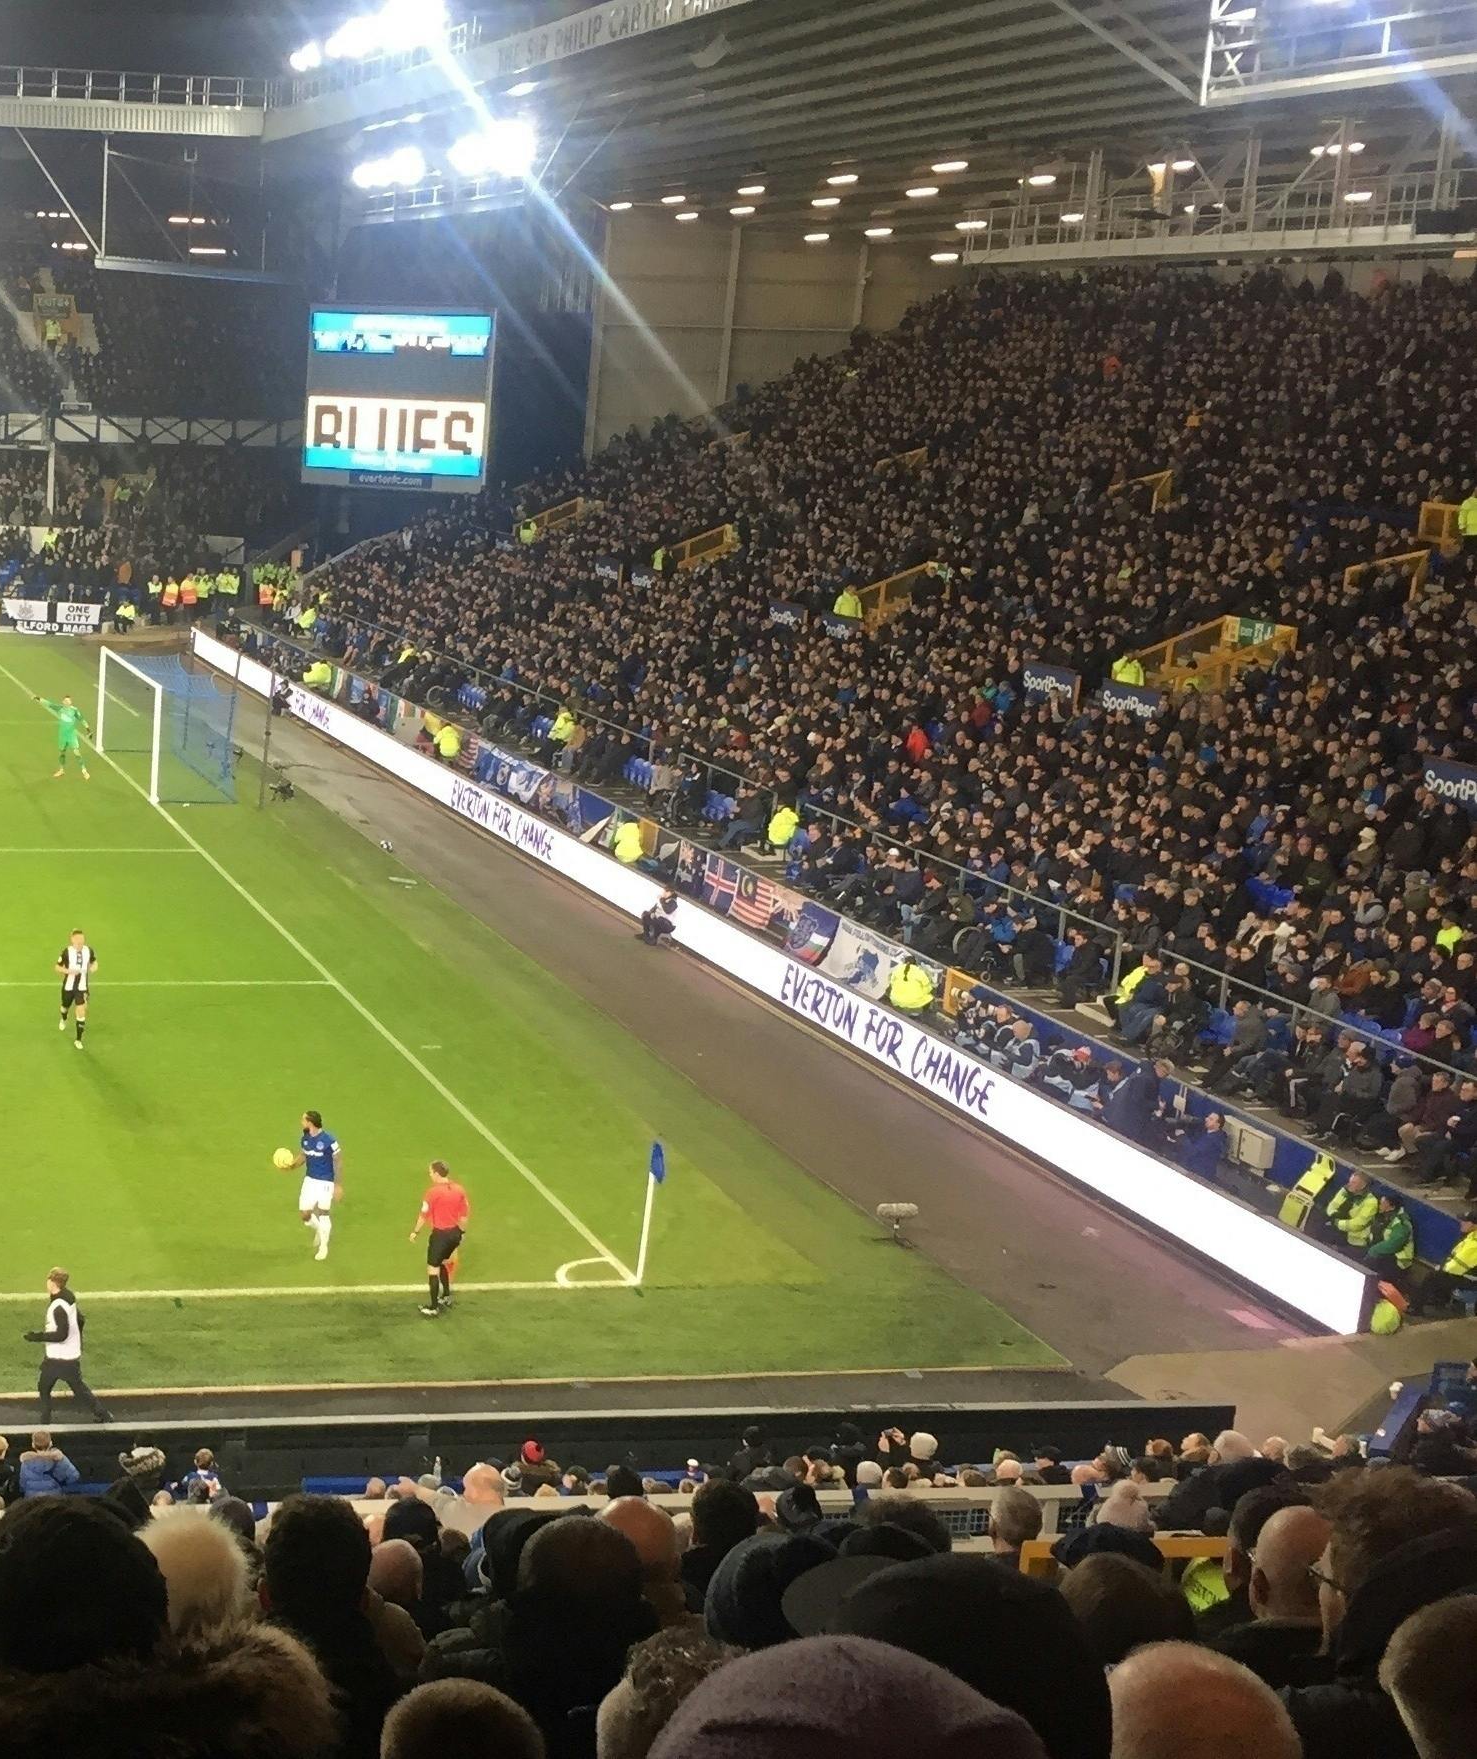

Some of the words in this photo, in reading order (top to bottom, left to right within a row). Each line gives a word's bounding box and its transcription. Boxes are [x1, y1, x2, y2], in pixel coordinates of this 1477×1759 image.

[554, 15, 602, 57] PHILIP
[65, 614, 90, 622] CITY
[68, 605, 90, 613] ONE
[63, 624, 94, 633] MAGS
[451, 779, 491, 824] EVERTON
[492, 801, 512, 839] FOR
[515, 814, 555, 860] CHANGE
[781, 963, 859, 1040] EVERTON
[864, 1008, 904, 1068] FOR
[911, 1035, 996, 1115] CHANGE
